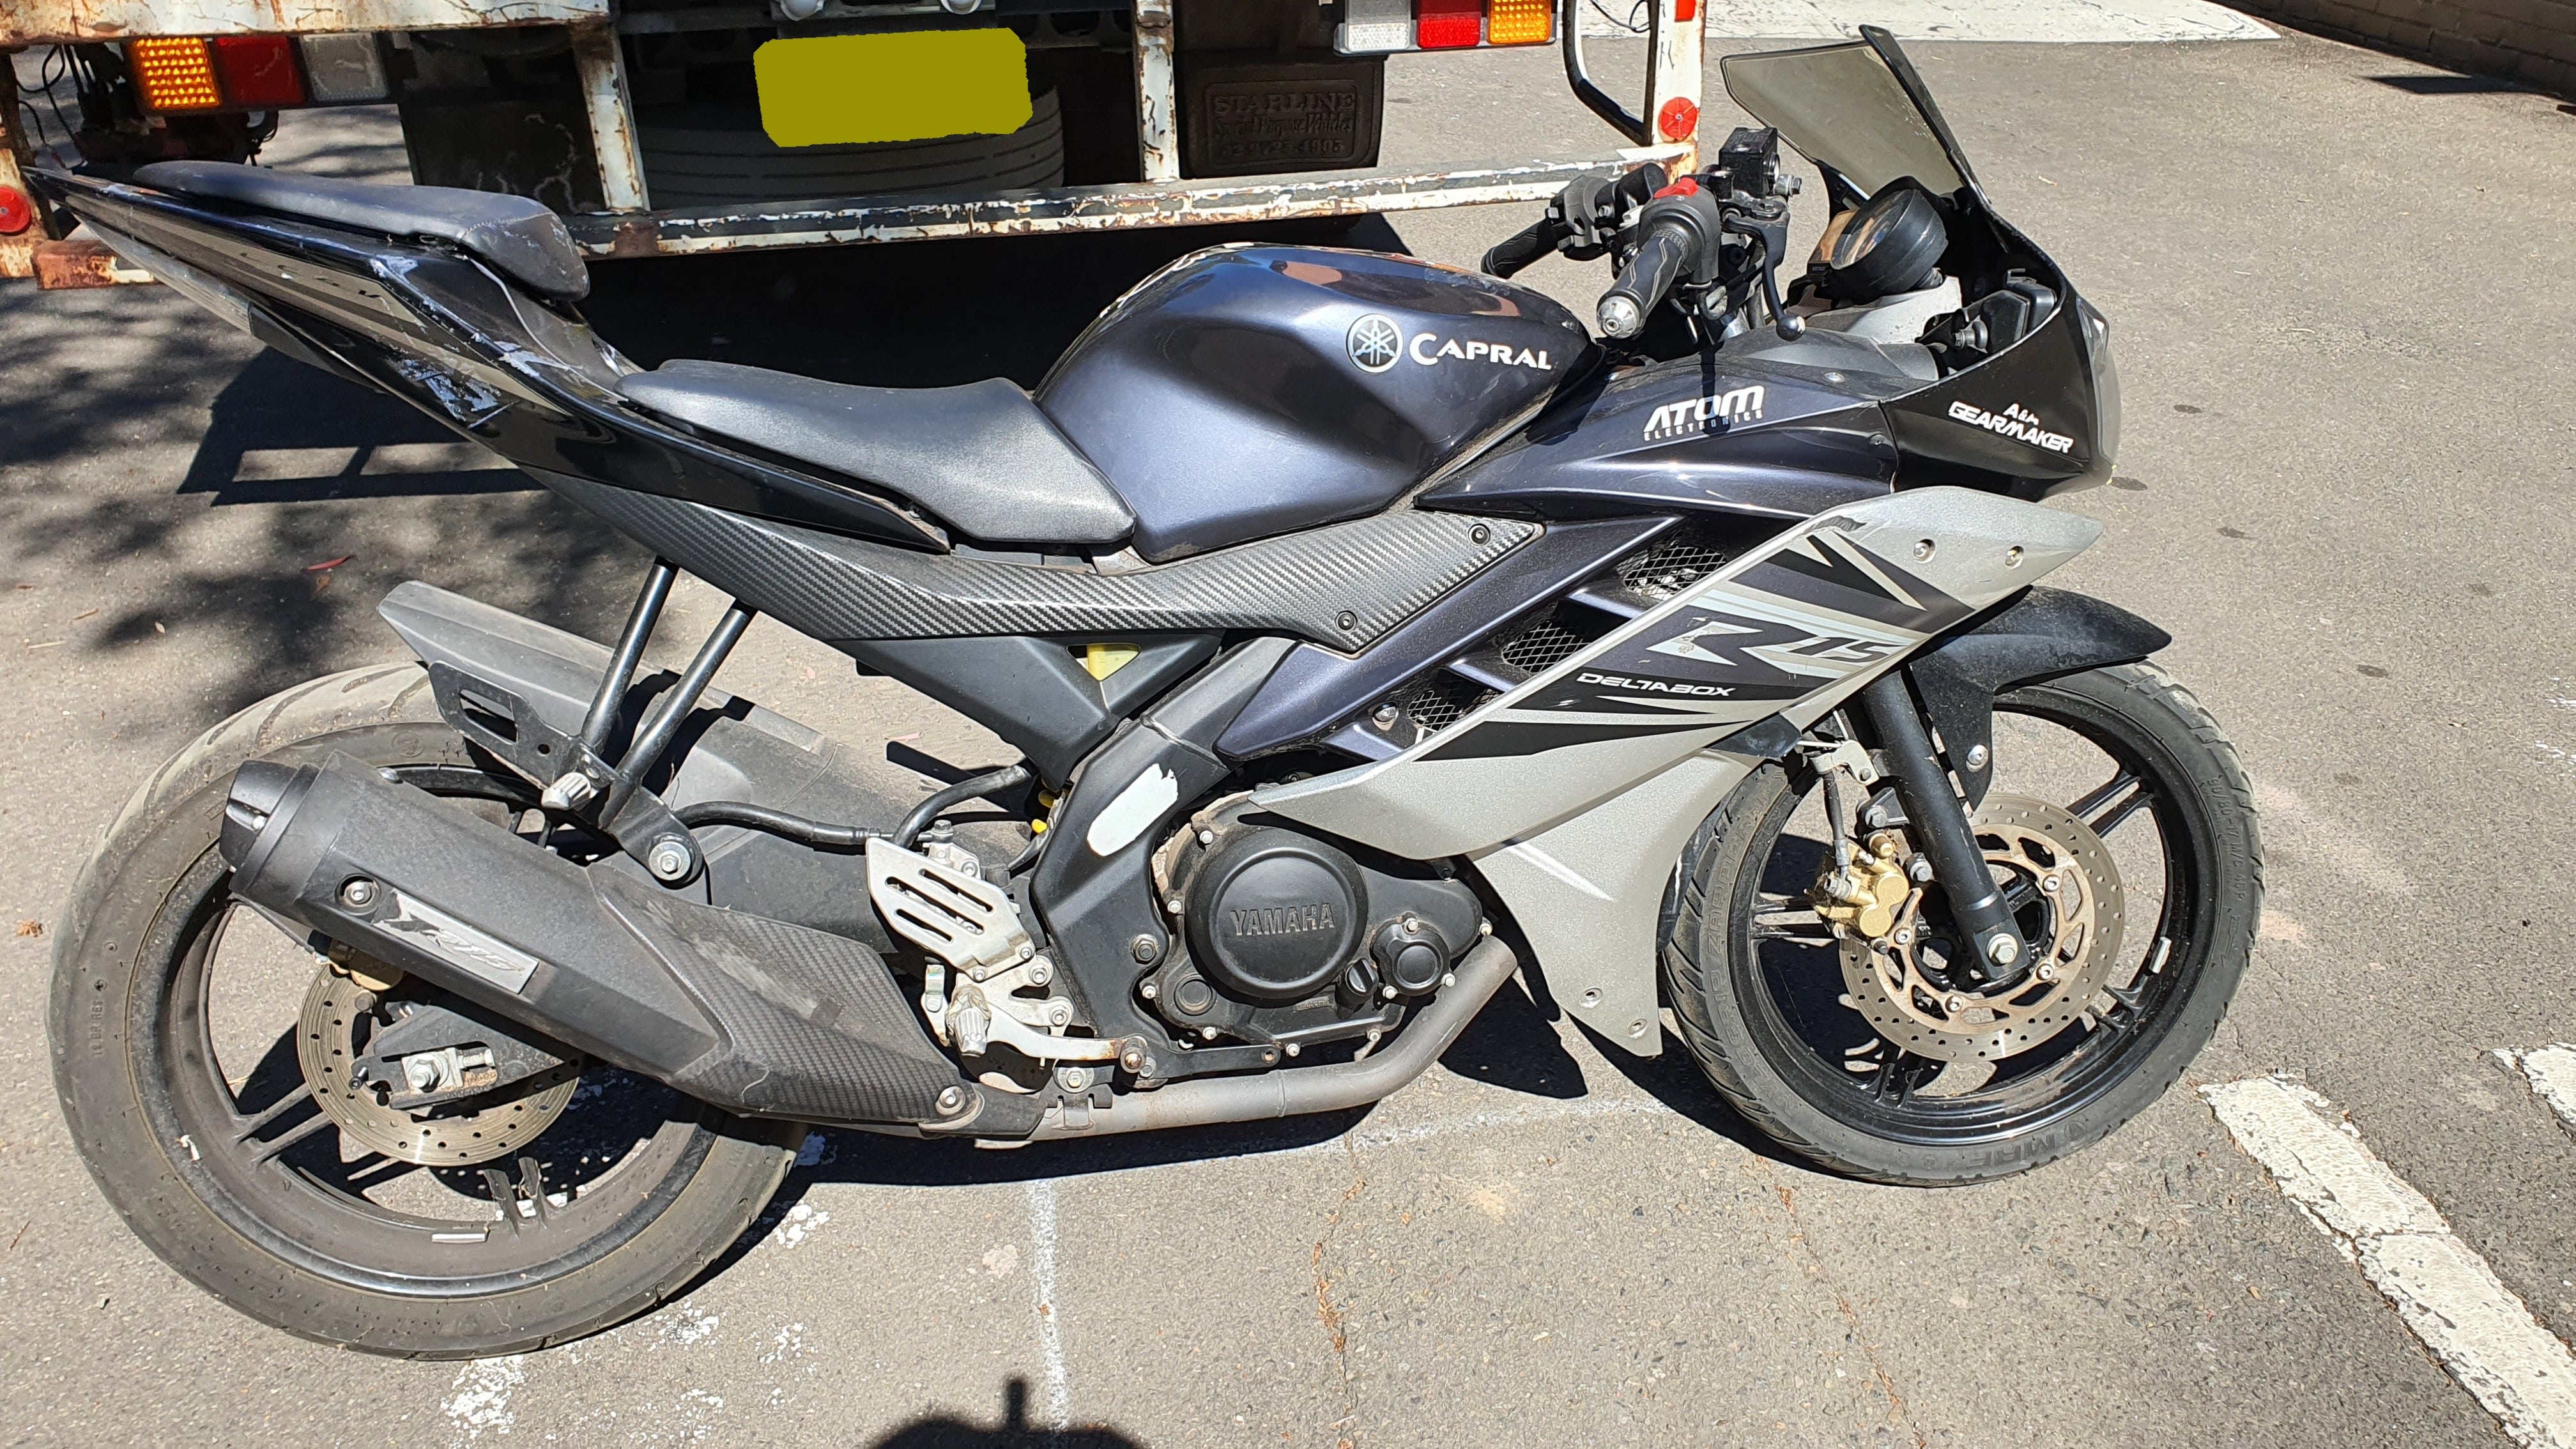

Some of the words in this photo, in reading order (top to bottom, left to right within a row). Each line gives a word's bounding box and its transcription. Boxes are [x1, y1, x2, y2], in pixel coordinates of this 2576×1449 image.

[1215, 92, 1356, 114] STARLINE
[1409, 332, 1552, 371] CAPRAL
[1643, 385, 1765, 433] ATOM
[1643, 408, 1763, 441] ELECTRONICS
[1947, 401, 2074, 454] GEARMAKER
[1576, 672, 1736, 697] DELTABOX
[1229, 902, 1335, 937] YAMAHA
